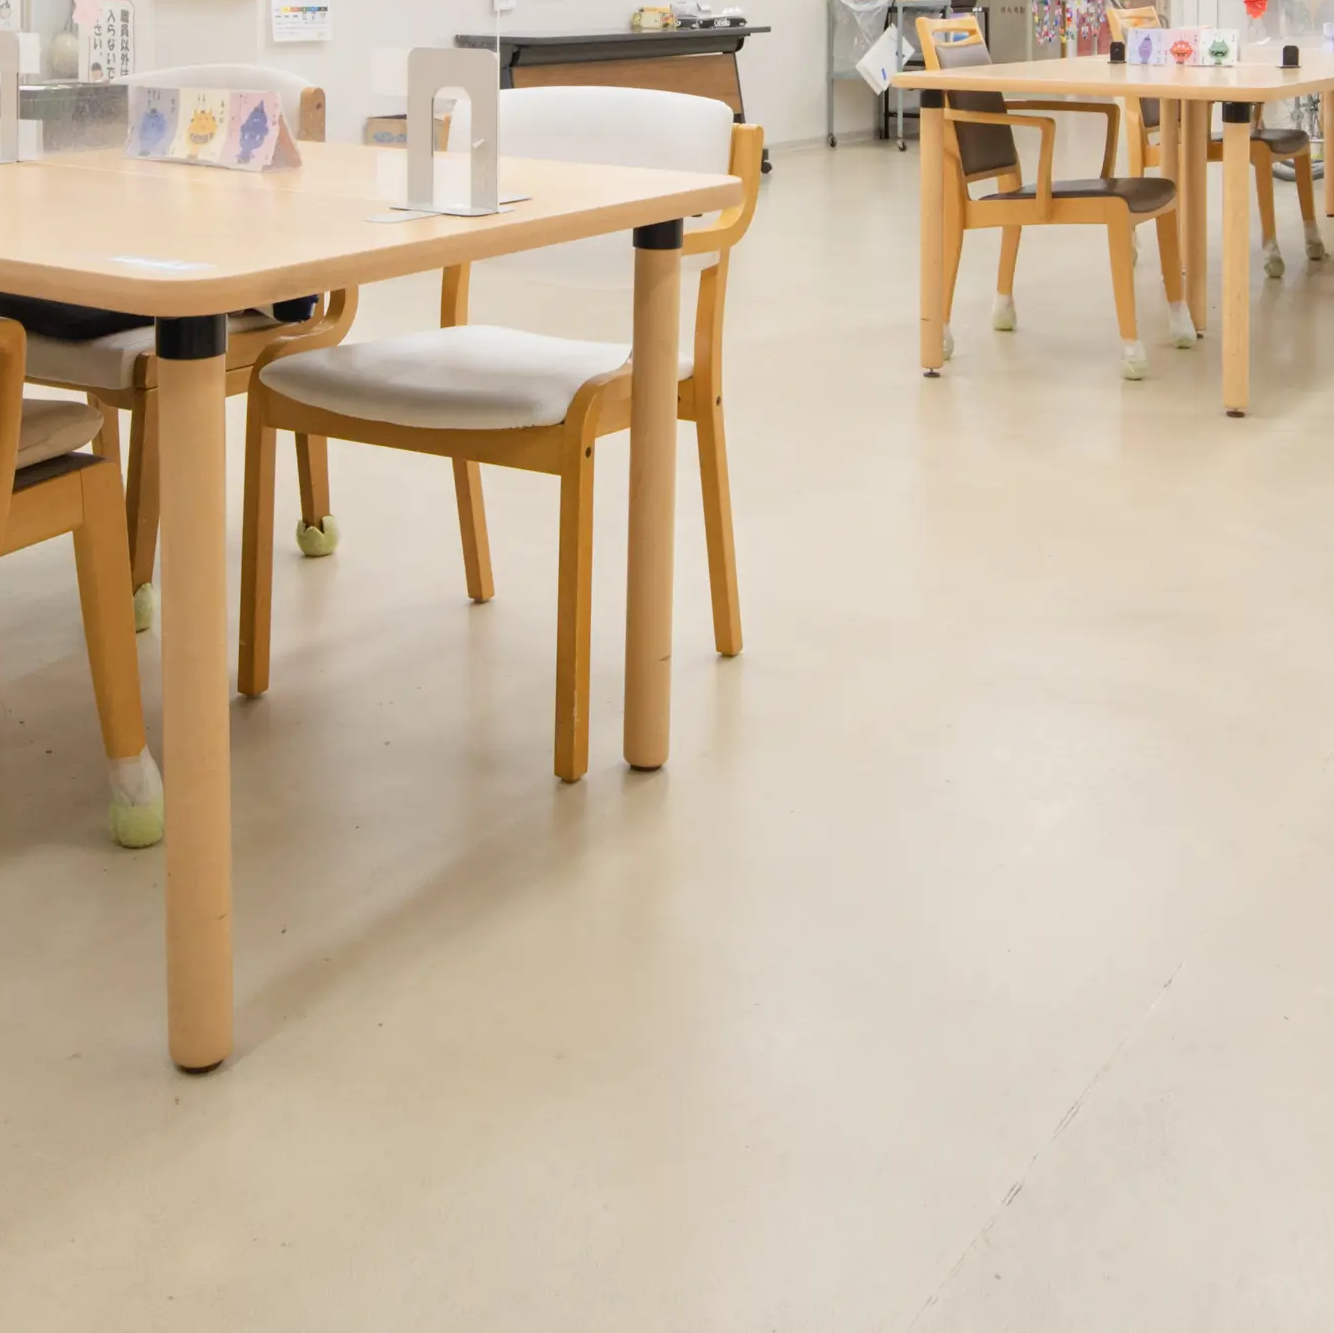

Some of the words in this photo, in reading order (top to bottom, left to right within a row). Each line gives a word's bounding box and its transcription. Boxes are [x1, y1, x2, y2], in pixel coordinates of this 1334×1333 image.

[106, 10, 117, 79] 入らないで
[120, 9, 131, 76] 職員以外は
